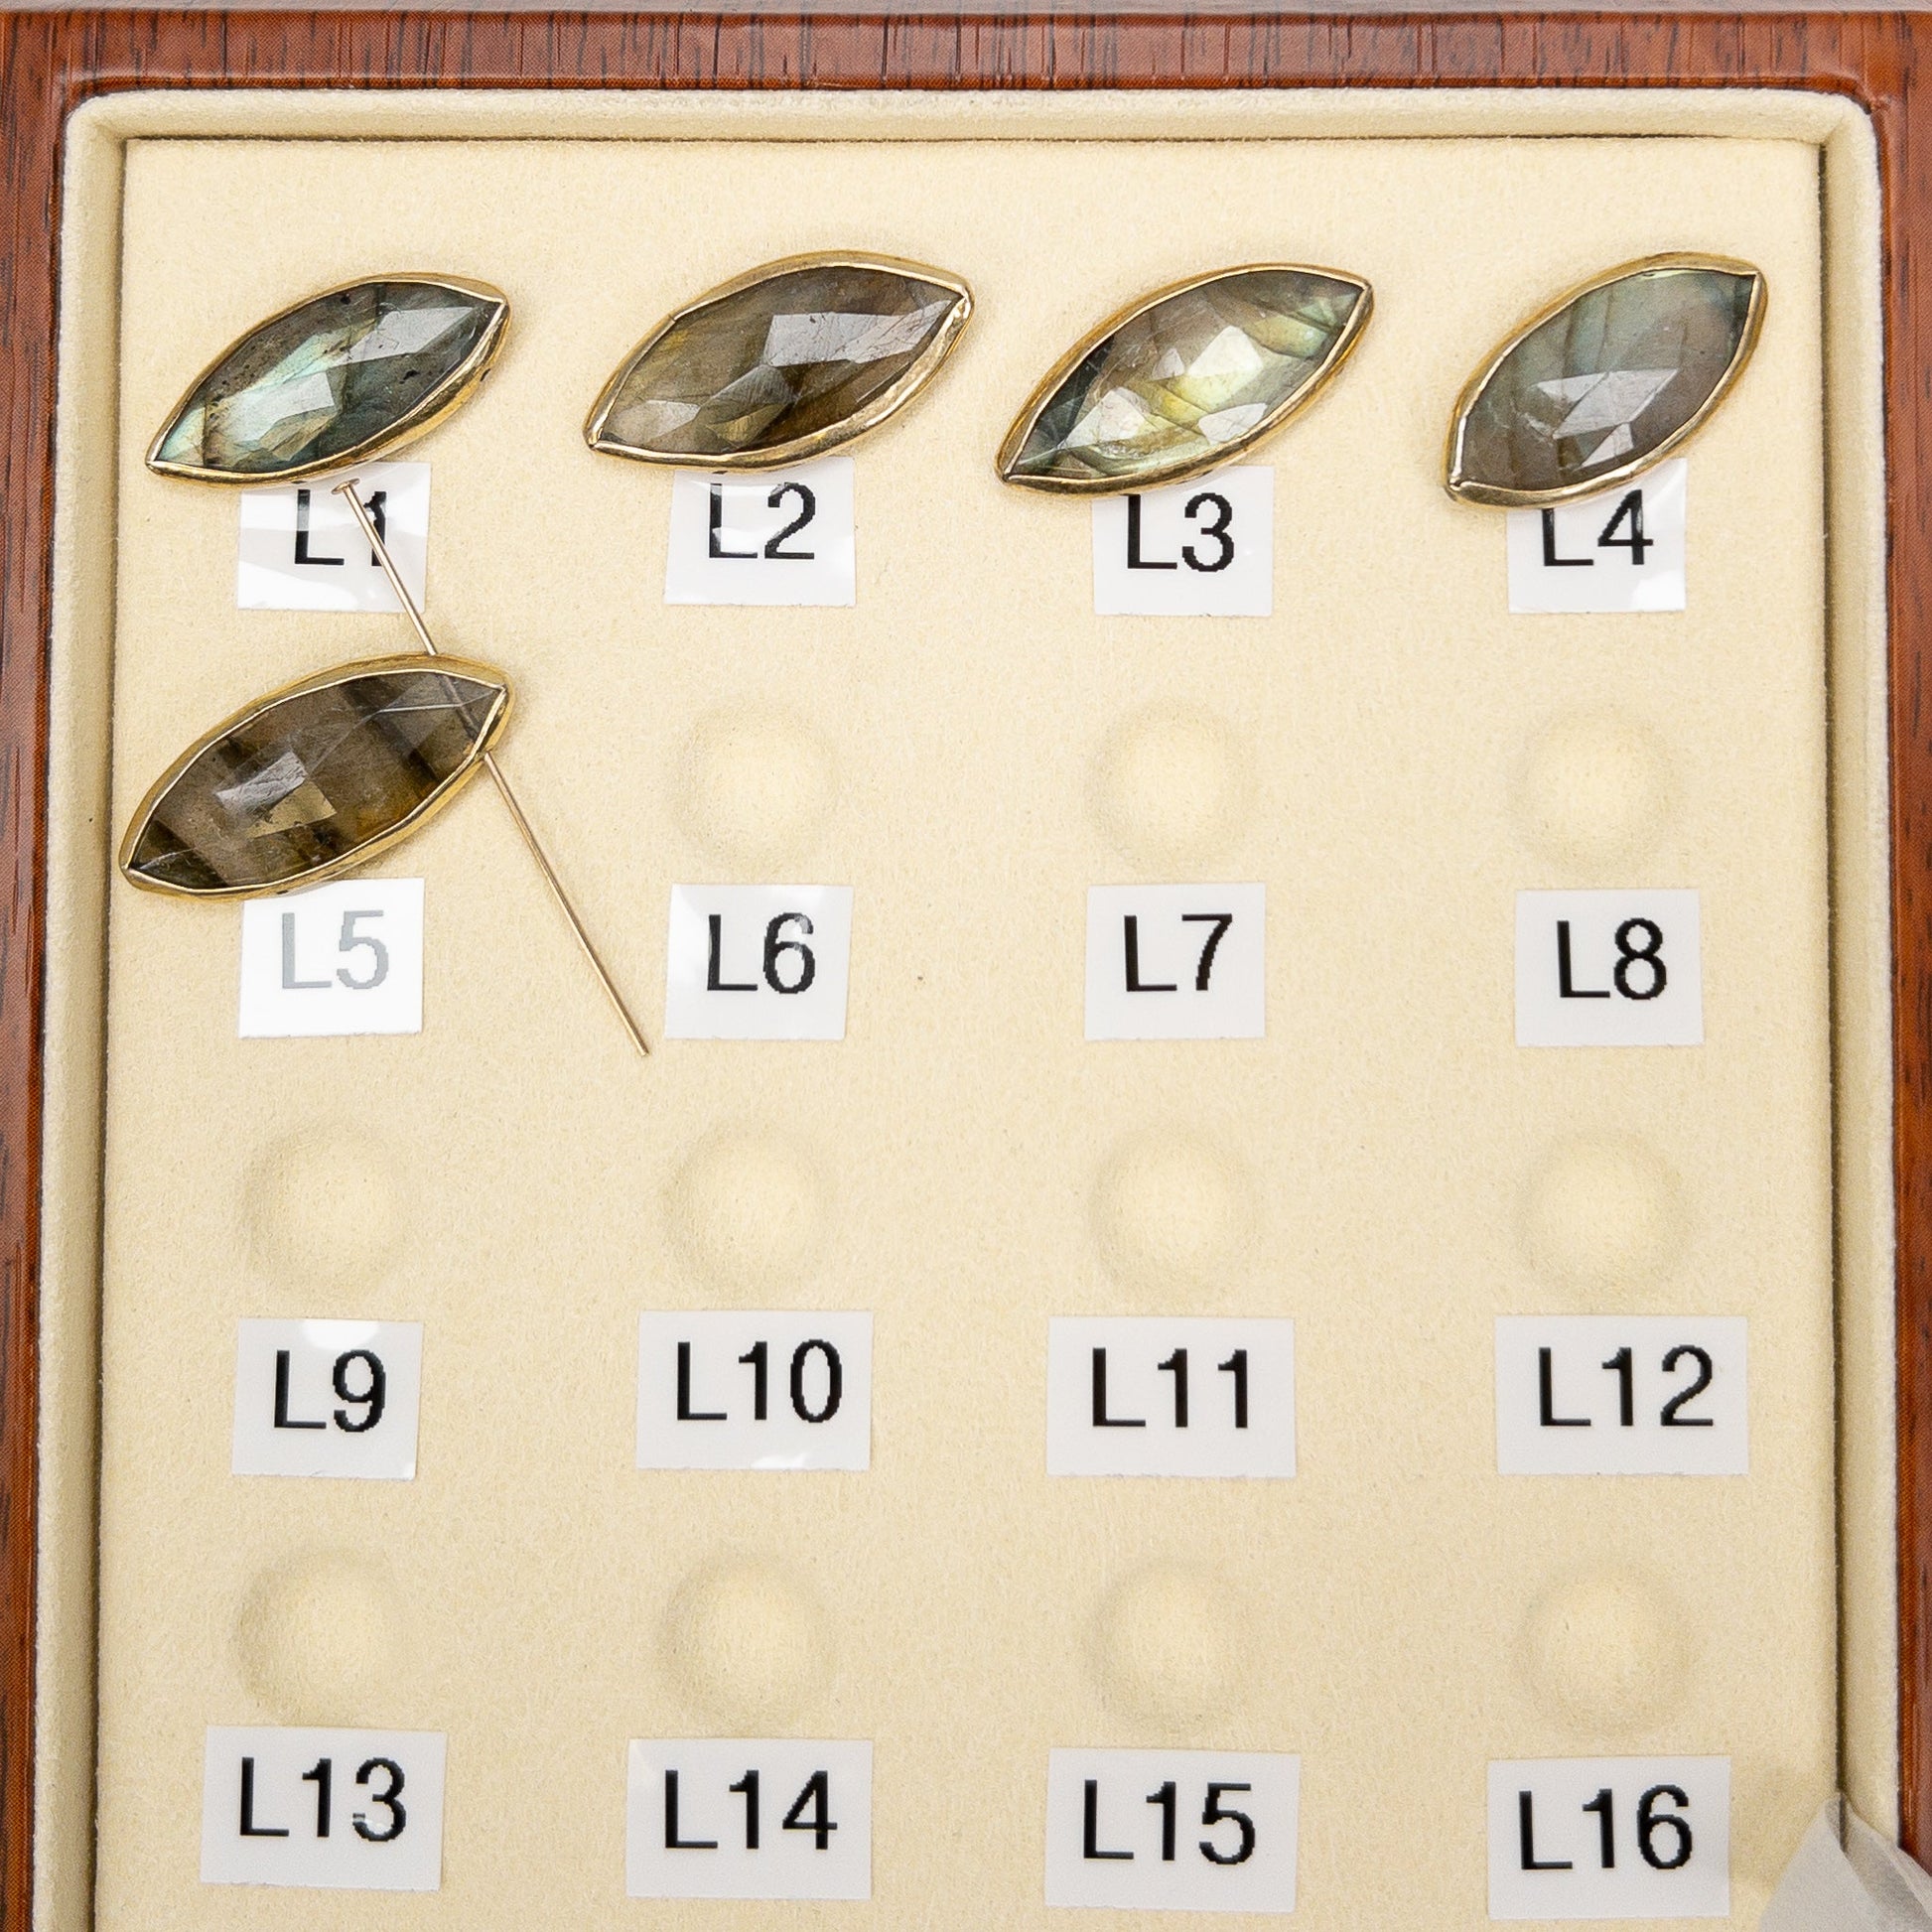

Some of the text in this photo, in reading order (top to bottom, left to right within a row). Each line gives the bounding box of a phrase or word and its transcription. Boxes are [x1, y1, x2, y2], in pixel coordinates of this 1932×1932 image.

[294, 489, 386, 567] L1
[710, 483, 816, 560] L2
[1127, 493, 1235, 573] L3
[1542, 488, 1654, 567] L4
[281, 909, 389, 990] L5
[707, 913, 816, 995] L6
[1124, 913, 1233, 993] L7
[1557, 918, 1668, 1001] L8
[273, 1349, 386, 1433] L9
[676, 1340, 843, 1424] L10
[1092, 1347, 1248, 1429] L11
[1539, 1345, 1714, 1427] L12
[239, 1757, 407, 1843] L13
[664, 1769, 838, 1851] L14
[1083, 1779, 1256, 1865] L15
[1519, 1785, 1693, 1870] L16
